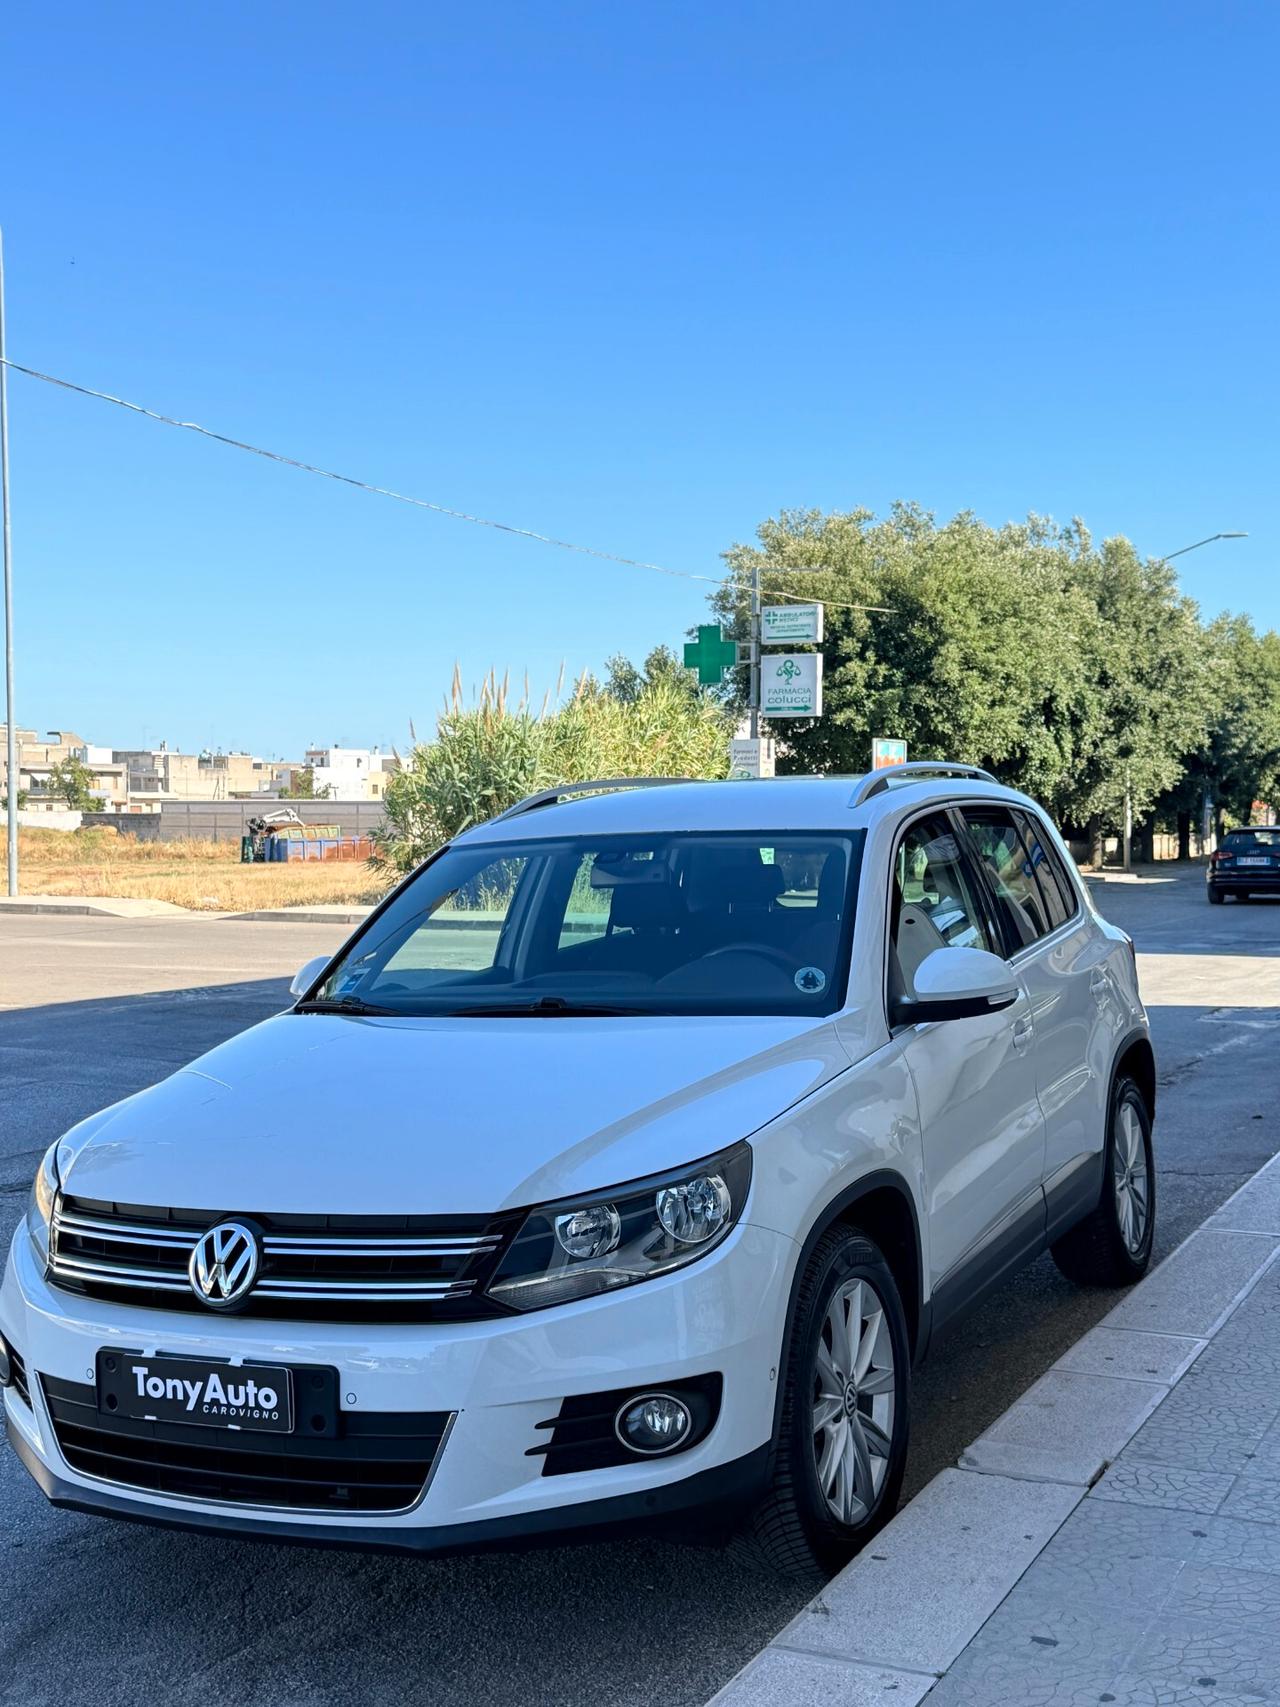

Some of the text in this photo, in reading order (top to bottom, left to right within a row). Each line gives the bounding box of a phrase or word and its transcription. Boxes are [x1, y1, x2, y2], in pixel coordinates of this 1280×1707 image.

[768, 687, 812, 695] FARMACIA
[767, 695, 811, 704] colucci
[132, 1366, 278, 1411] TonyAuto
[202, 1404, 279, 1420] CAROVIGNO
